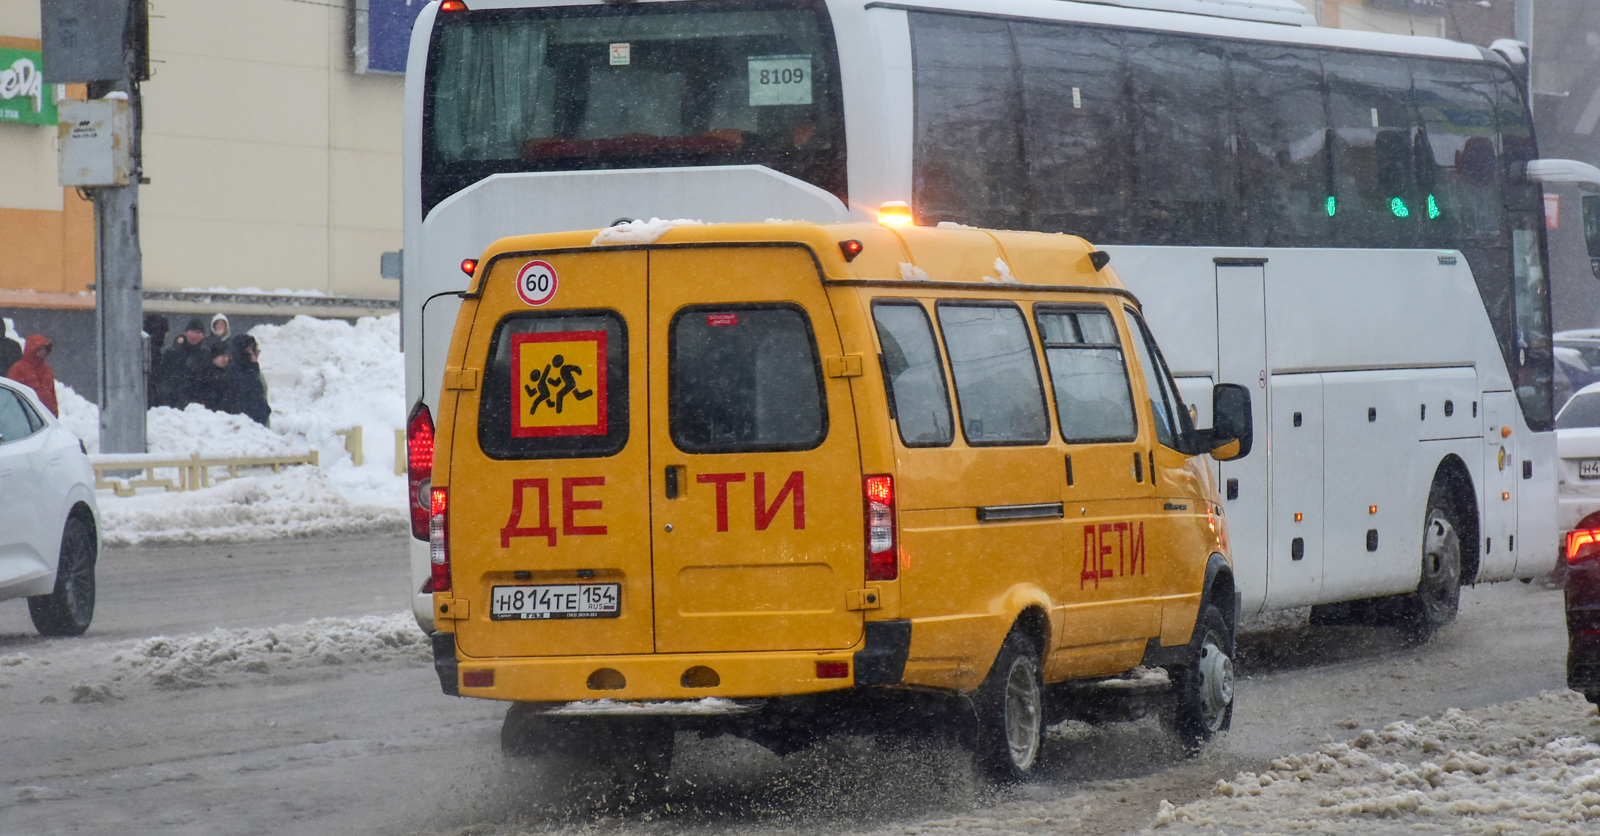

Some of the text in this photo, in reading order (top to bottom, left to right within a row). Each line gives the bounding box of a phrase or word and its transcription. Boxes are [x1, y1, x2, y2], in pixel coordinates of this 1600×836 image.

[759, 68, 804, 85] 8109
[525, 273, 549, 293] 60
[1080, 521, 1146, 591] ДЕТИ
[582, 586, 612, 603] 154
